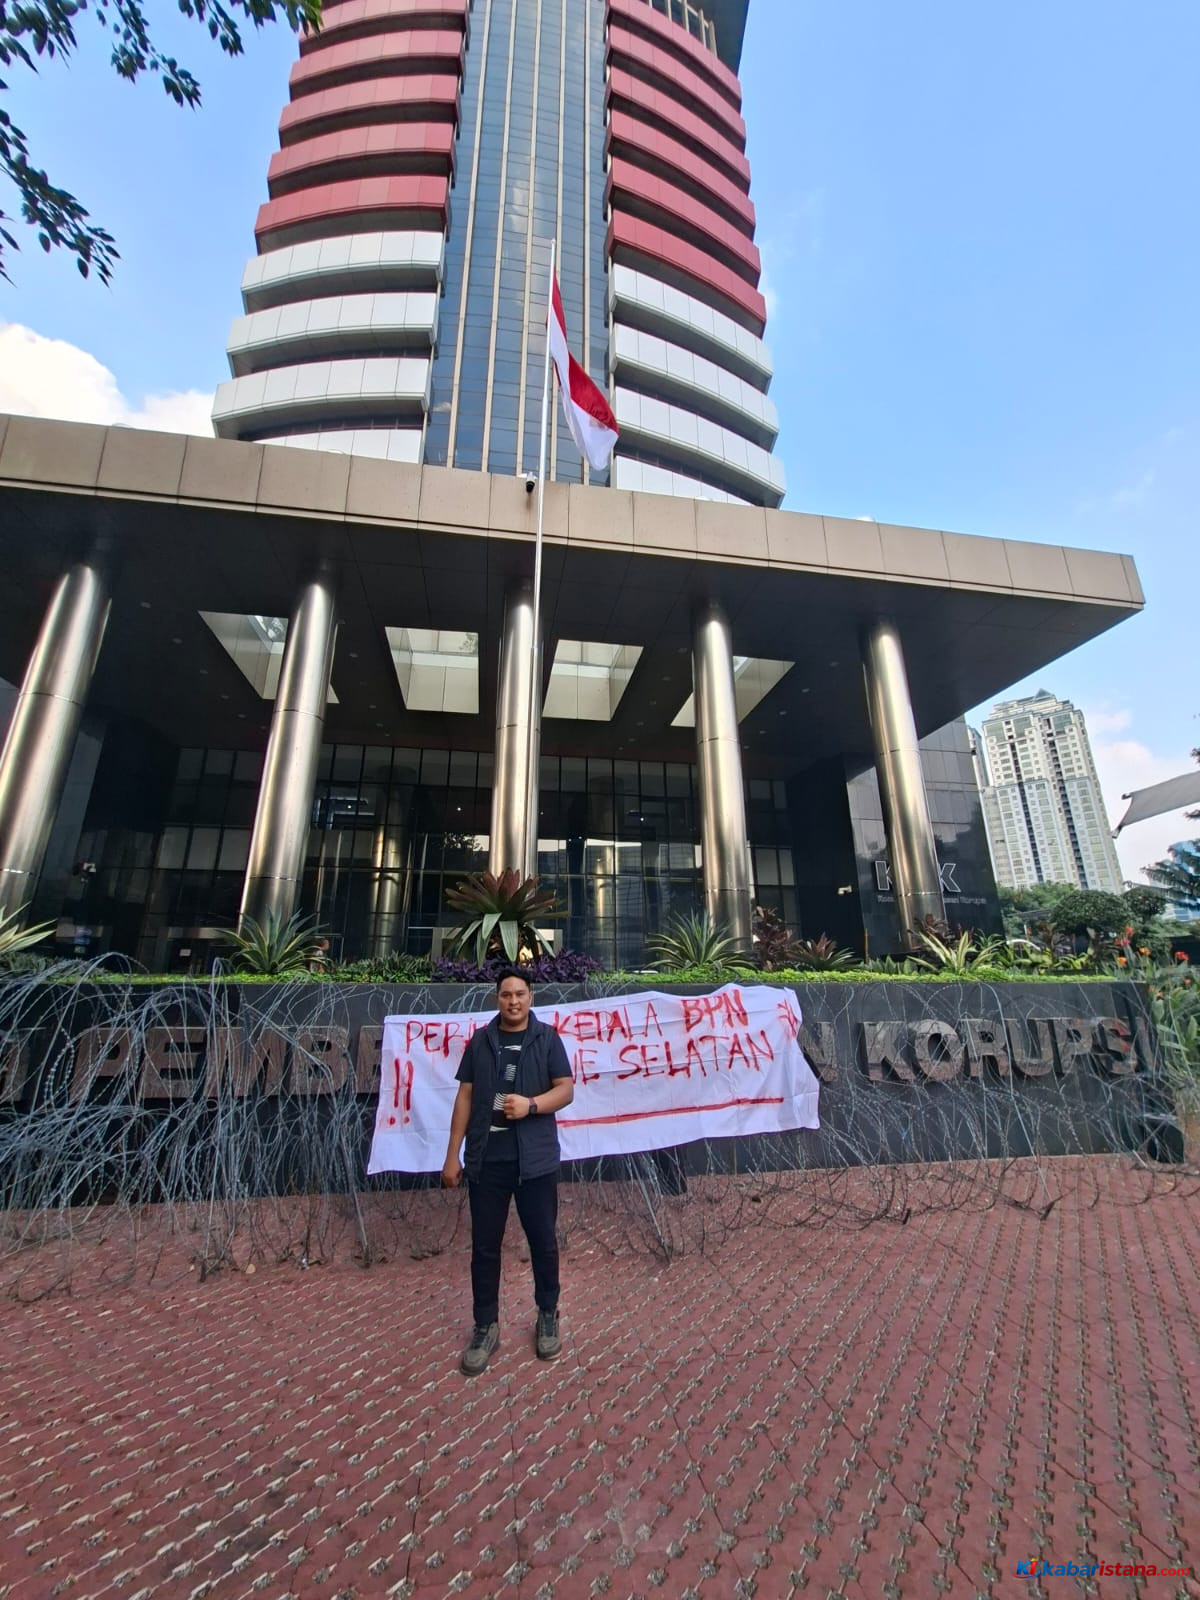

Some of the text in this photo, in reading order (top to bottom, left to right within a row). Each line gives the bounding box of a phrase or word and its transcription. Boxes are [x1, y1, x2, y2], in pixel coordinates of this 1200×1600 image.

[553, 1003, 662, 1043] KEPALA
[681, 989, 748, 1033] BPN
[617, 1030, 774, 1079] SELATAN
